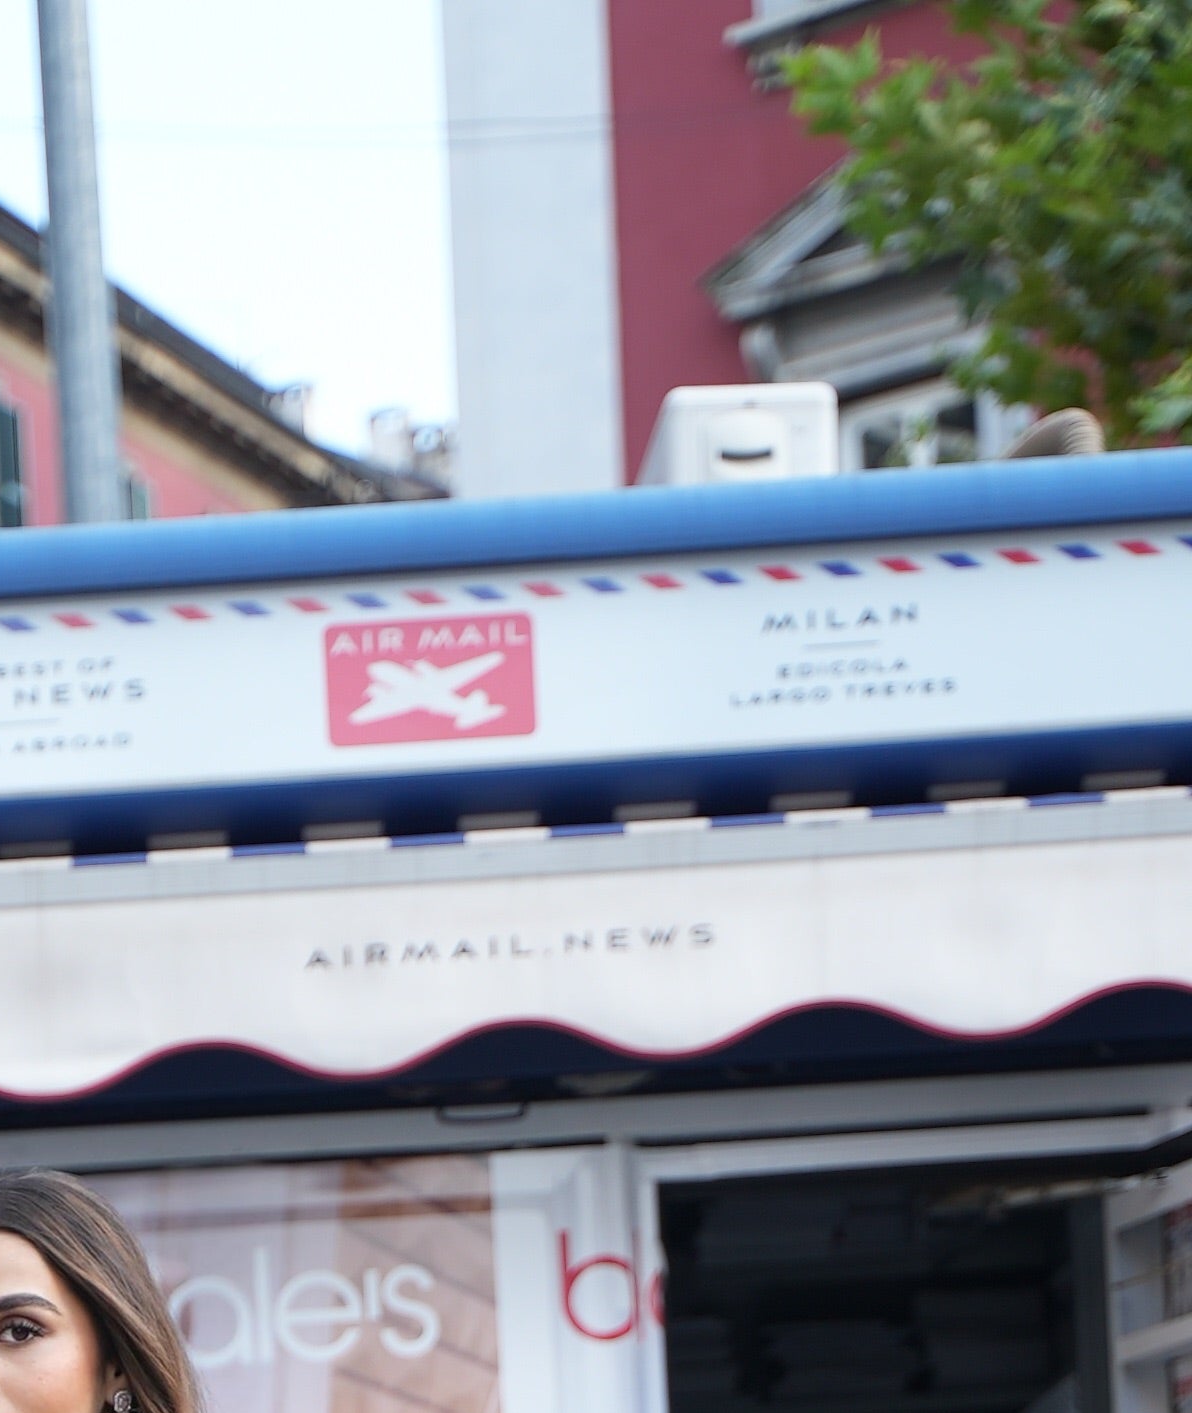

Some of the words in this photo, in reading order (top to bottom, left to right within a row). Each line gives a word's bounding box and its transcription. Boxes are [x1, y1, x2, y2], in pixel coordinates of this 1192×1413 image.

[762, 602, 919, 634] MILAN
[330, 627, 405, 656] AIR
[416, 619, 528, 650] MAIL
[76, 656, 116, 675] OF
[776, 657, 908, 680] EDICOLA
[13, 678, 146, 708] NEWS
[729, 686, 832, 710] LARGO
[844, 676, 958, 699] TREVES
[11, 732, 132, 753] ABROAD
[305, 923, 716, 969] AIRMAIL.NEWS
